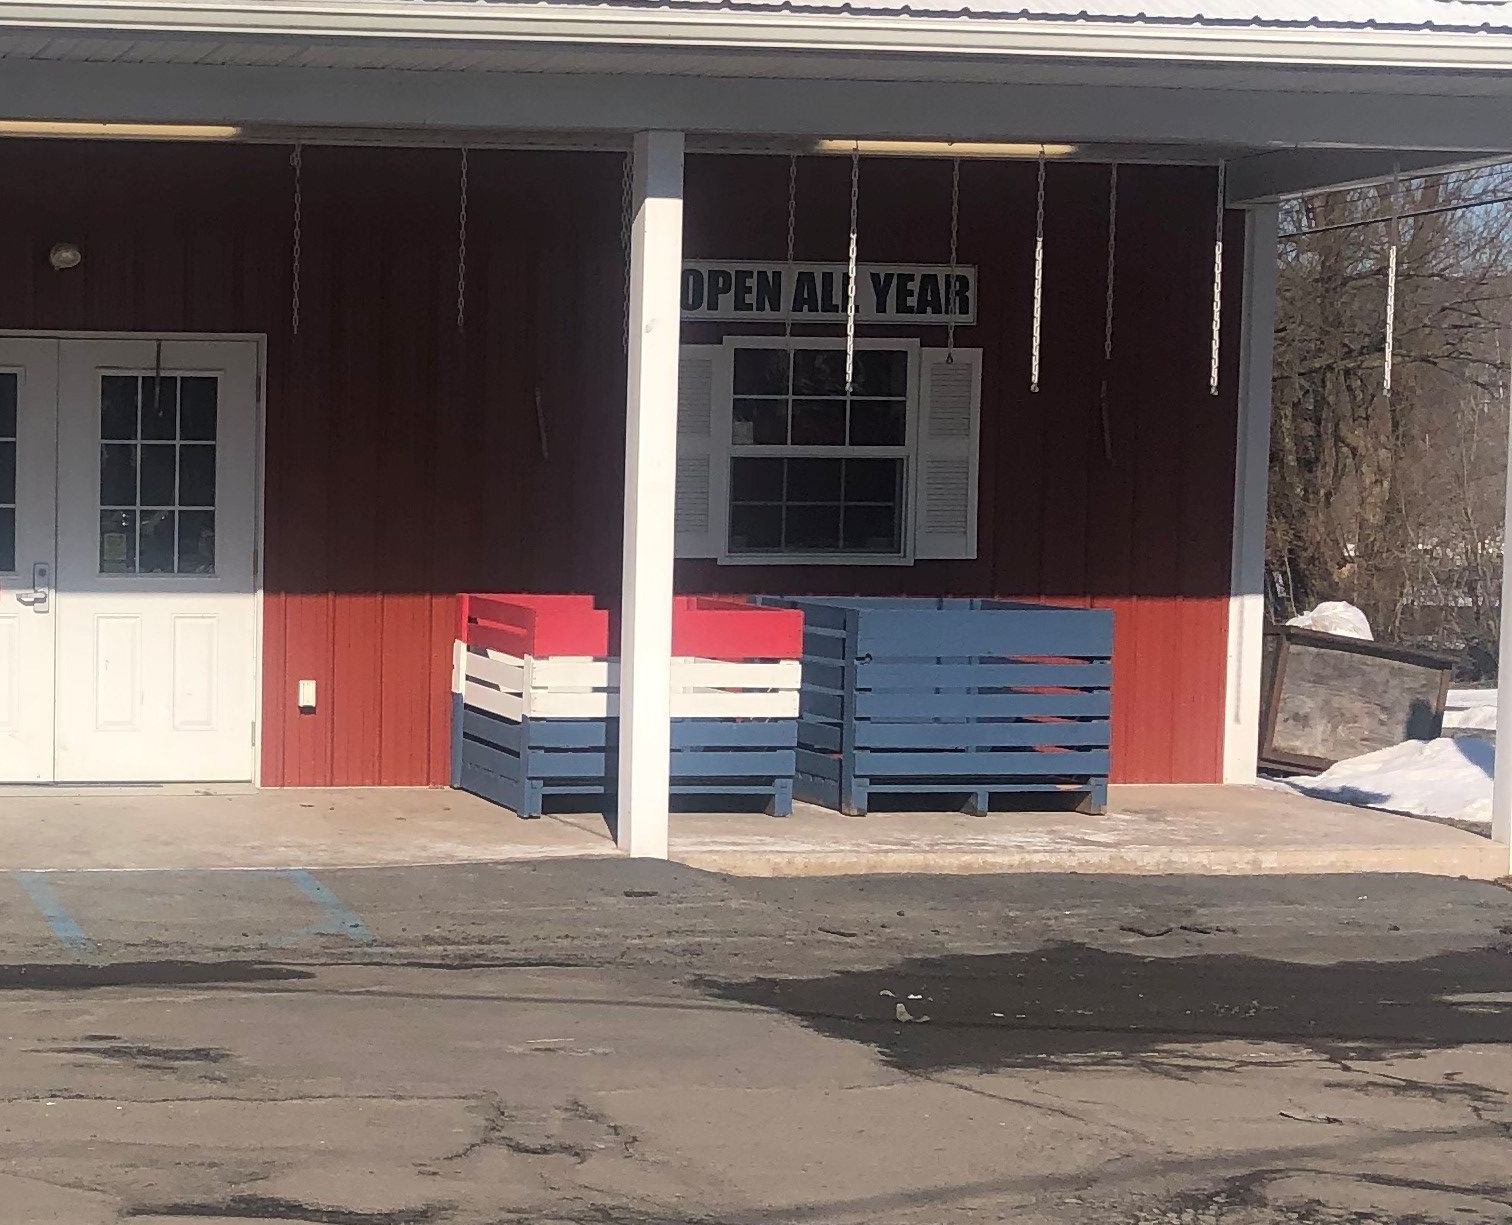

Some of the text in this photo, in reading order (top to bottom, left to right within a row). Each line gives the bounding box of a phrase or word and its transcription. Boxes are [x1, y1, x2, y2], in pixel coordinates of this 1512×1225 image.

[680, 269, 971, 315] OPEN ALL YEAR
